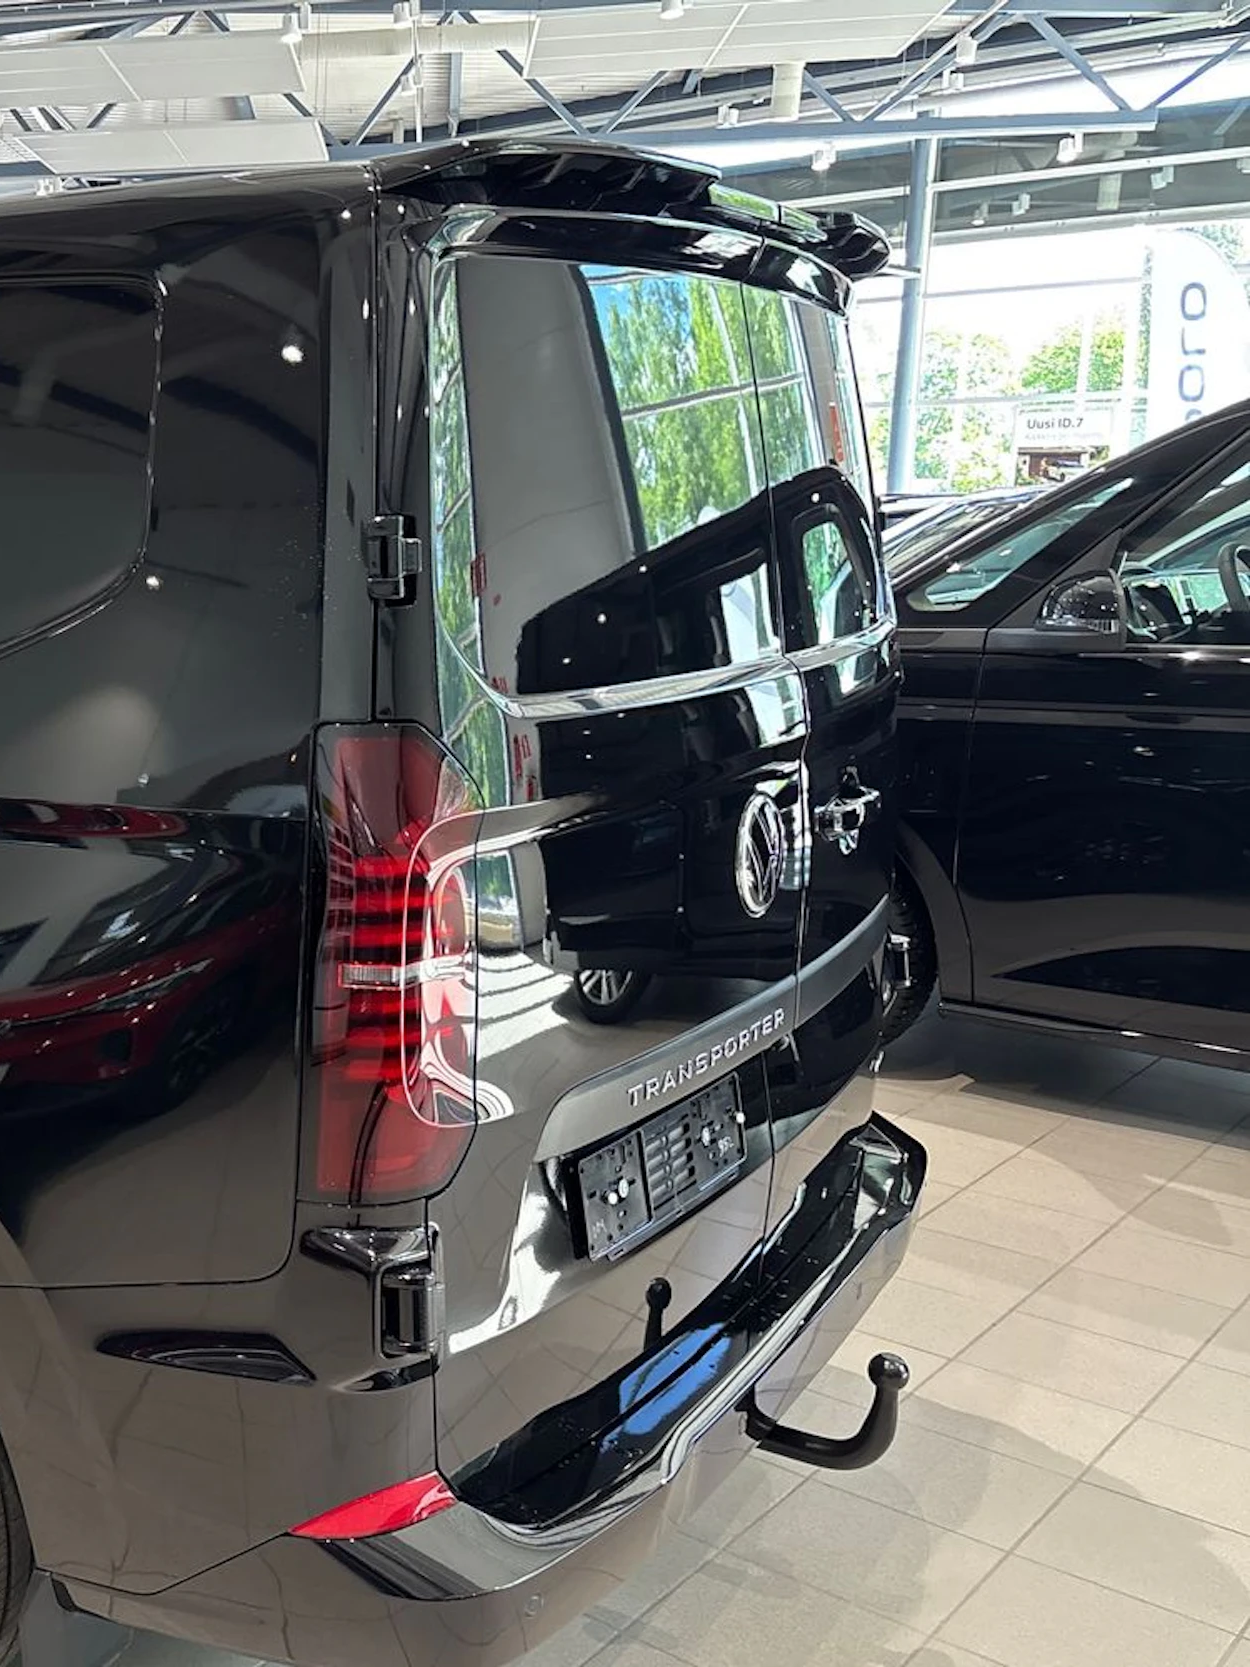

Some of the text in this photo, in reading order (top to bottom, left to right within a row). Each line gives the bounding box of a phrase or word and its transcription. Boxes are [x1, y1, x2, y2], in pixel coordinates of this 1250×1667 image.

[1027, 417, 1084, 430] Uusi ID.7
[626, 1007, 787, 1108] TRANSPORTER
